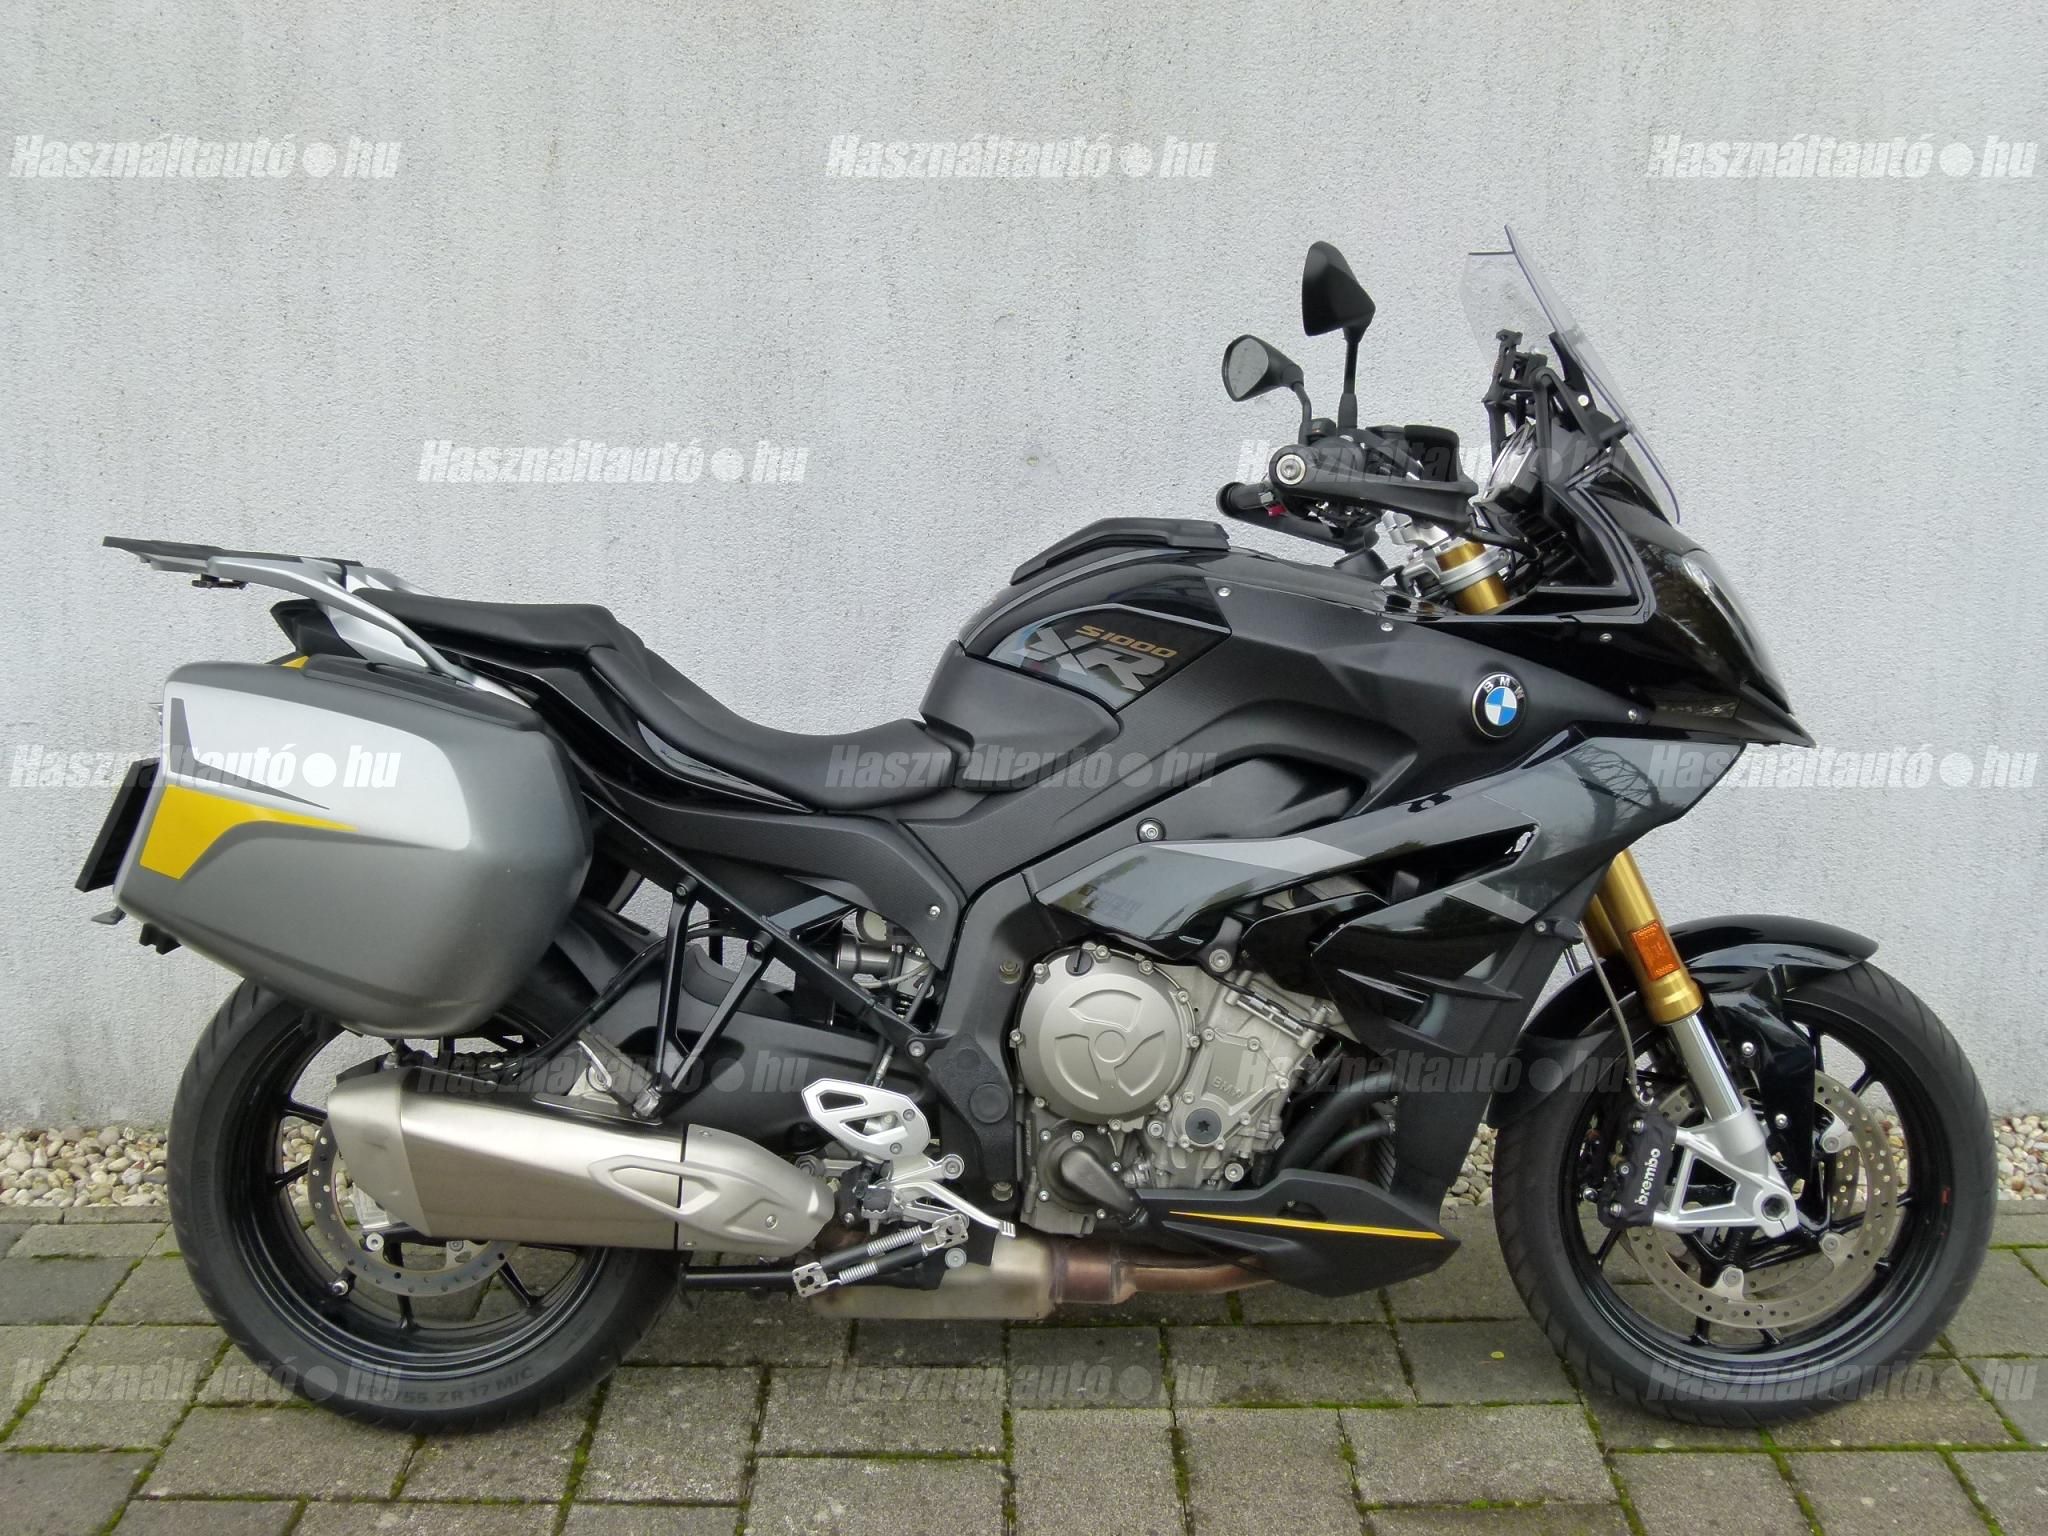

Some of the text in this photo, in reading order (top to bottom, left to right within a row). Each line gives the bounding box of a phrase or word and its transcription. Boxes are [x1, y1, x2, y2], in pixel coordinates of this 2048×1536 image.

[1075, 624, 1178, 659] S1000
[1482, 676, 1525, 700] BMW
[1634, 1148, 1661, 1206] brembo
